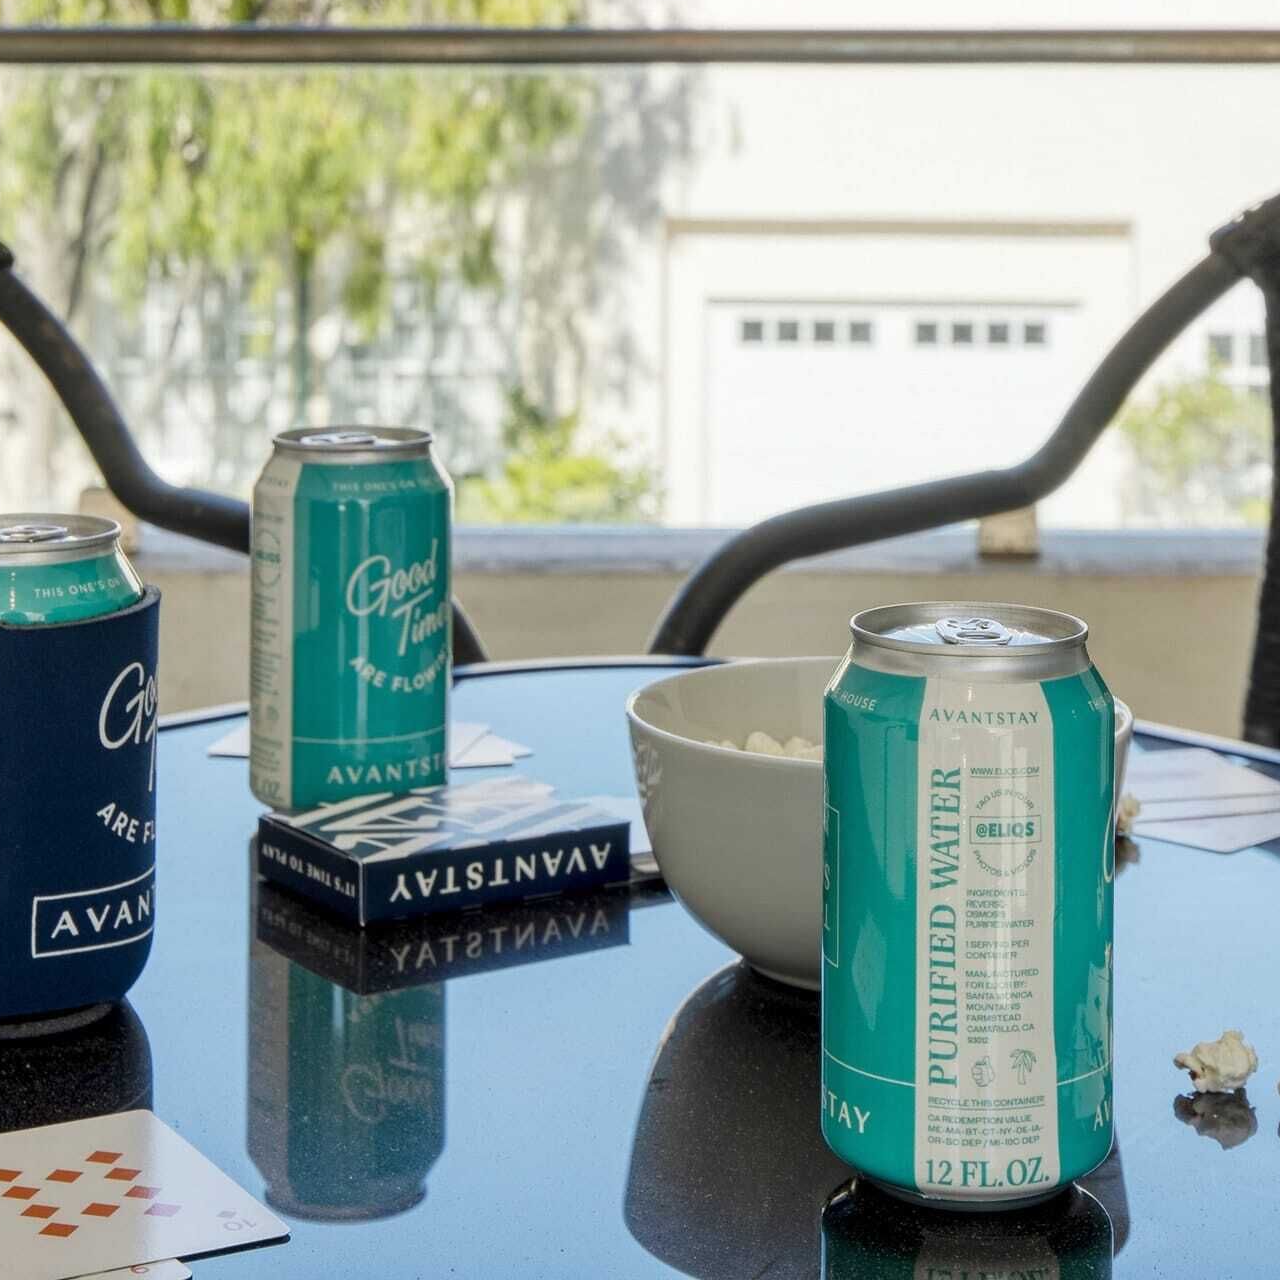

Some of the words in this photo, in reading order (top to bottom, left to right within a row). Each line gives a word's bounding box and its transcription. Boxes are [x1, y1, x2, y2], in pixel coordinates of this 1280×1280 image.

[34, 587, 64, 599] THIS
[69, 581, 106, 596] ONE'S
[346, 538, 438, 617] Good
[349, 656, 387, 688] ARE
[928, 708, 1040, 725] AVANTSTAY
[96, 803, 139, 843] ARE
[930, 767, 961, 890] WATER
[975, 821, 1035, 839] @ELIQS
[261, 843, 288, 866] PLAY
[289, 855, 304, 874] TO
[306, 861, 332, 888] TIME
[389, 842, 611, 903] AVANTSTAY
[334, 876, 356, 898] IT'S
[927, 903, 958, 1088] PURIFIED
[965, 981, 984, 990] FOR
[928, 1096, 969, 1107] RECYCLE
[925, 1159, 953, 1186] 12
